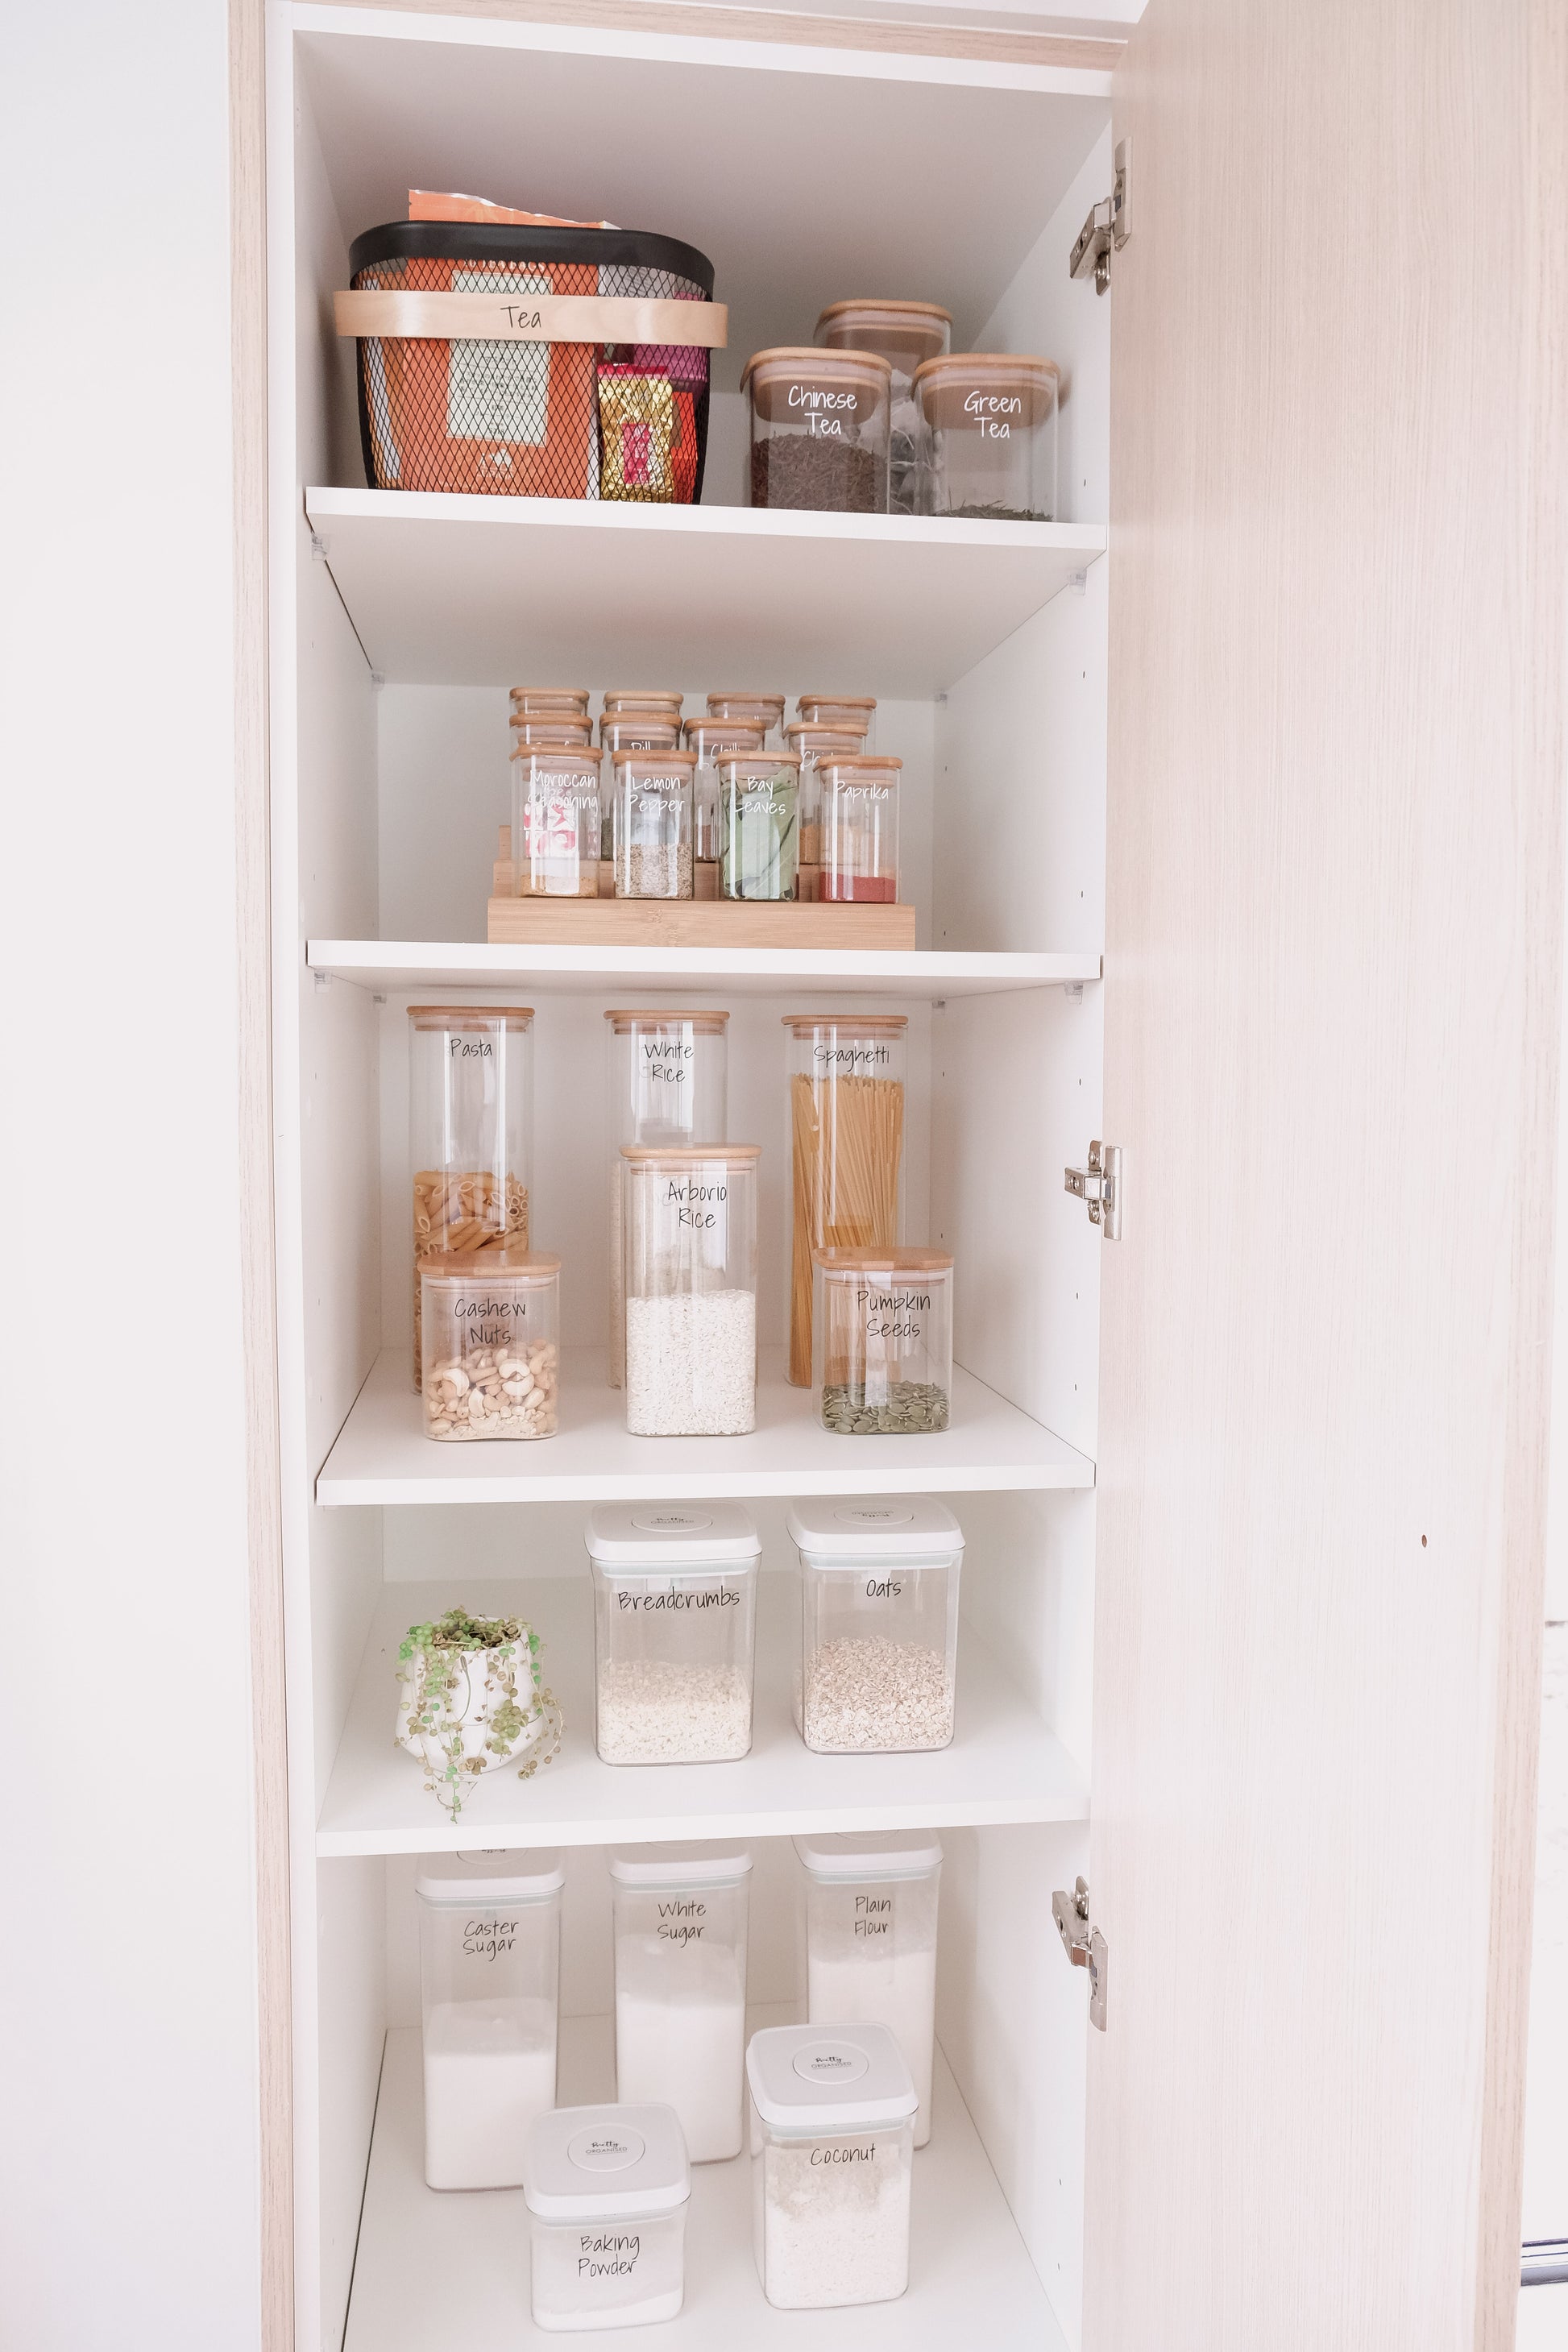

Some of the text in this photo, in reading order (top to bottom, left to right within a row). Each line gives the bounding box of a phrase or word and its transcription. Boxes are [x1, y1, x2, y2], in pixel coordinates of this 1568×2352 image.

[500, 305, 541, 330] Tea
[788, 384, 857, 411] Chinese
[964, 391, 1022, 414] Green
[804, 412, 842, 436] Tea
[974, 417, 1010, 439] Tea
[529, 769, 596, 789] Moroccan
[632, 776, 681, 790] Lemon
[747, 776, 774, 799] Bay
[836, 780, 890, 804] Paprika
[628, 794, 686, 817] Pepper
[734, 799, 786, 815] Leaves
[450, 1038, 493, 1057] Pasta
[644, 1041, 695, 1059] White
[814, 1045, 890, 1072] Spaghetti
[652, 1064, 686, 1083] Rice
[668, 1180, 728, 1202] Arborio
[678, 1207, 716, 1229] Rice
[454, 1298, 526, 1318] Cashew
[857, 1290, 931, 1317] Pumpkin
[470, 1324, 512, 1345] Nuts
[866, 1315, 921, 1338] Seeds
[618, 1585, 740, 1611] Breadcrumbs
[866, 1578, 902, 1598] Oats
[657, 1900, 707, 1918] White
[855, 1896, 891, 1914] Plain
[463, 1919, 519, 1937] Caster
[657, 1923, 705, 1948] Sugar
[854, 1919, 889, 1937] Flour
[463, 1939, 516, 1962] Sugar
[811, 2143, 876, 2166] Coconut
[580, 2234, 641, 2260] Baking
[579, 2254, 637, 2278] Powder
